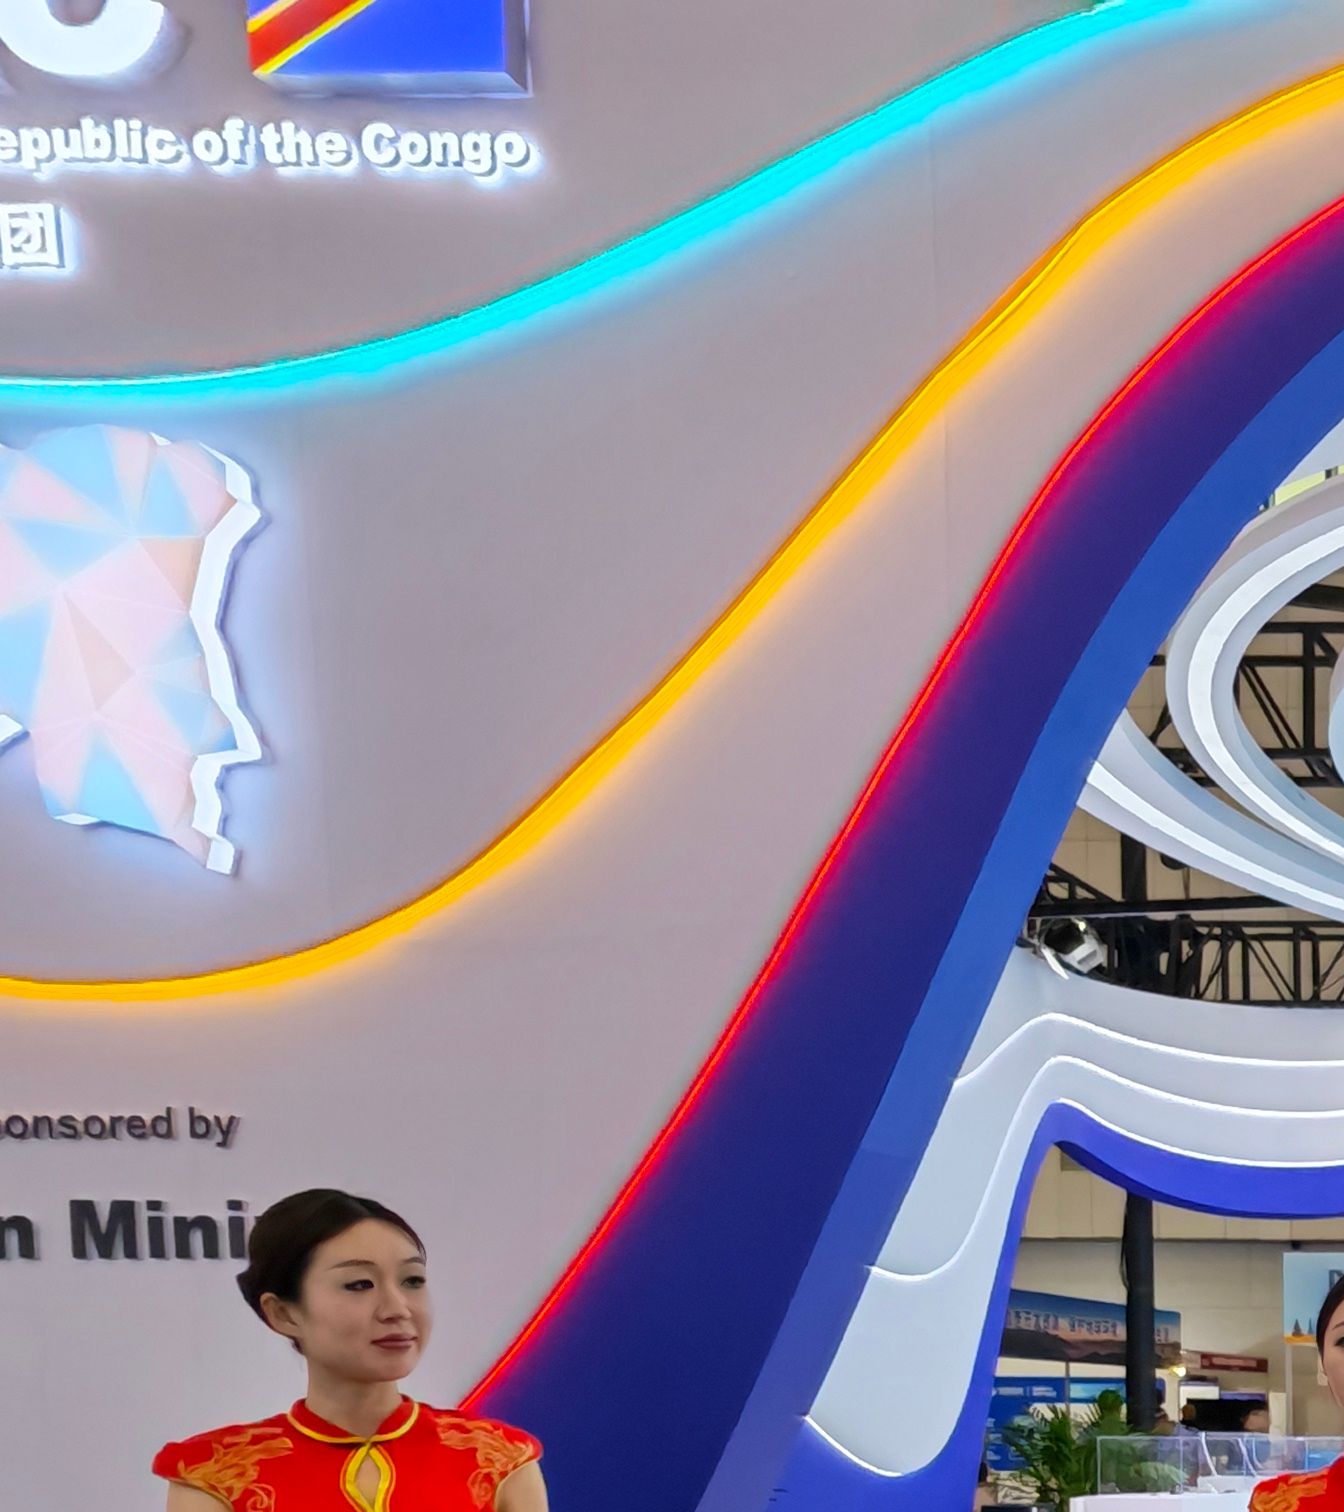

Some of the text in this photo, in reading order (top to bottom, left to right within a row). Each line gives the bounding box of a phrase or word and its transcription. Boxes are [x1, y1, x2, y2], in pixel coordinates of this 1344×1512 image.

[192, 118, 245, 163] of
[260, 120, 347, 164] the
[361, 122, 527, 176] Congo
[0, 1106, 237, 1148] onsored by
[69, 1199, 262, 1259] Mini
